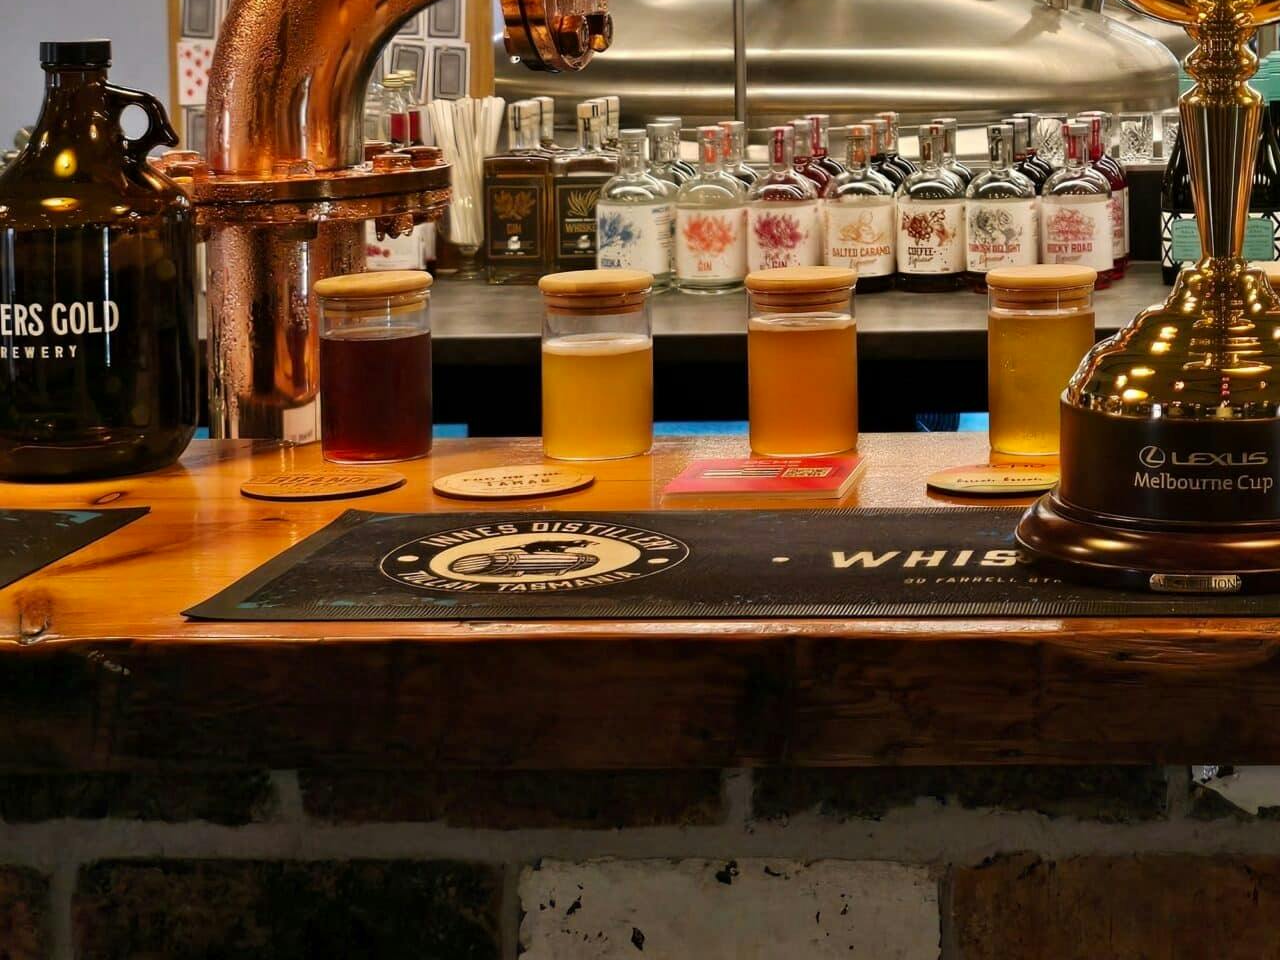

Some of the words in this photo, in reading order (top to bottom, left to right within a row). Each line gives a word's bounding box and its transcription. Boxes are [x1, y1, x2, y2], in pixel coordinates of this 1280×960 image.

[832, 247, 859, 257] SALTED
[51, 300, 120, 335] GOLD
[1171, 451, 1269, 466] LEXUS
[1133, 471, 1234, 491] Melbourne
[1237, 474, 1274, 495] Cup
[419, 524, 519, 548] INNES
[530, 522, 681, 551] DISTILLERY
[831, 549, 1022, 568] WHIS
[497, 571, 642, 592] TASMANIA
